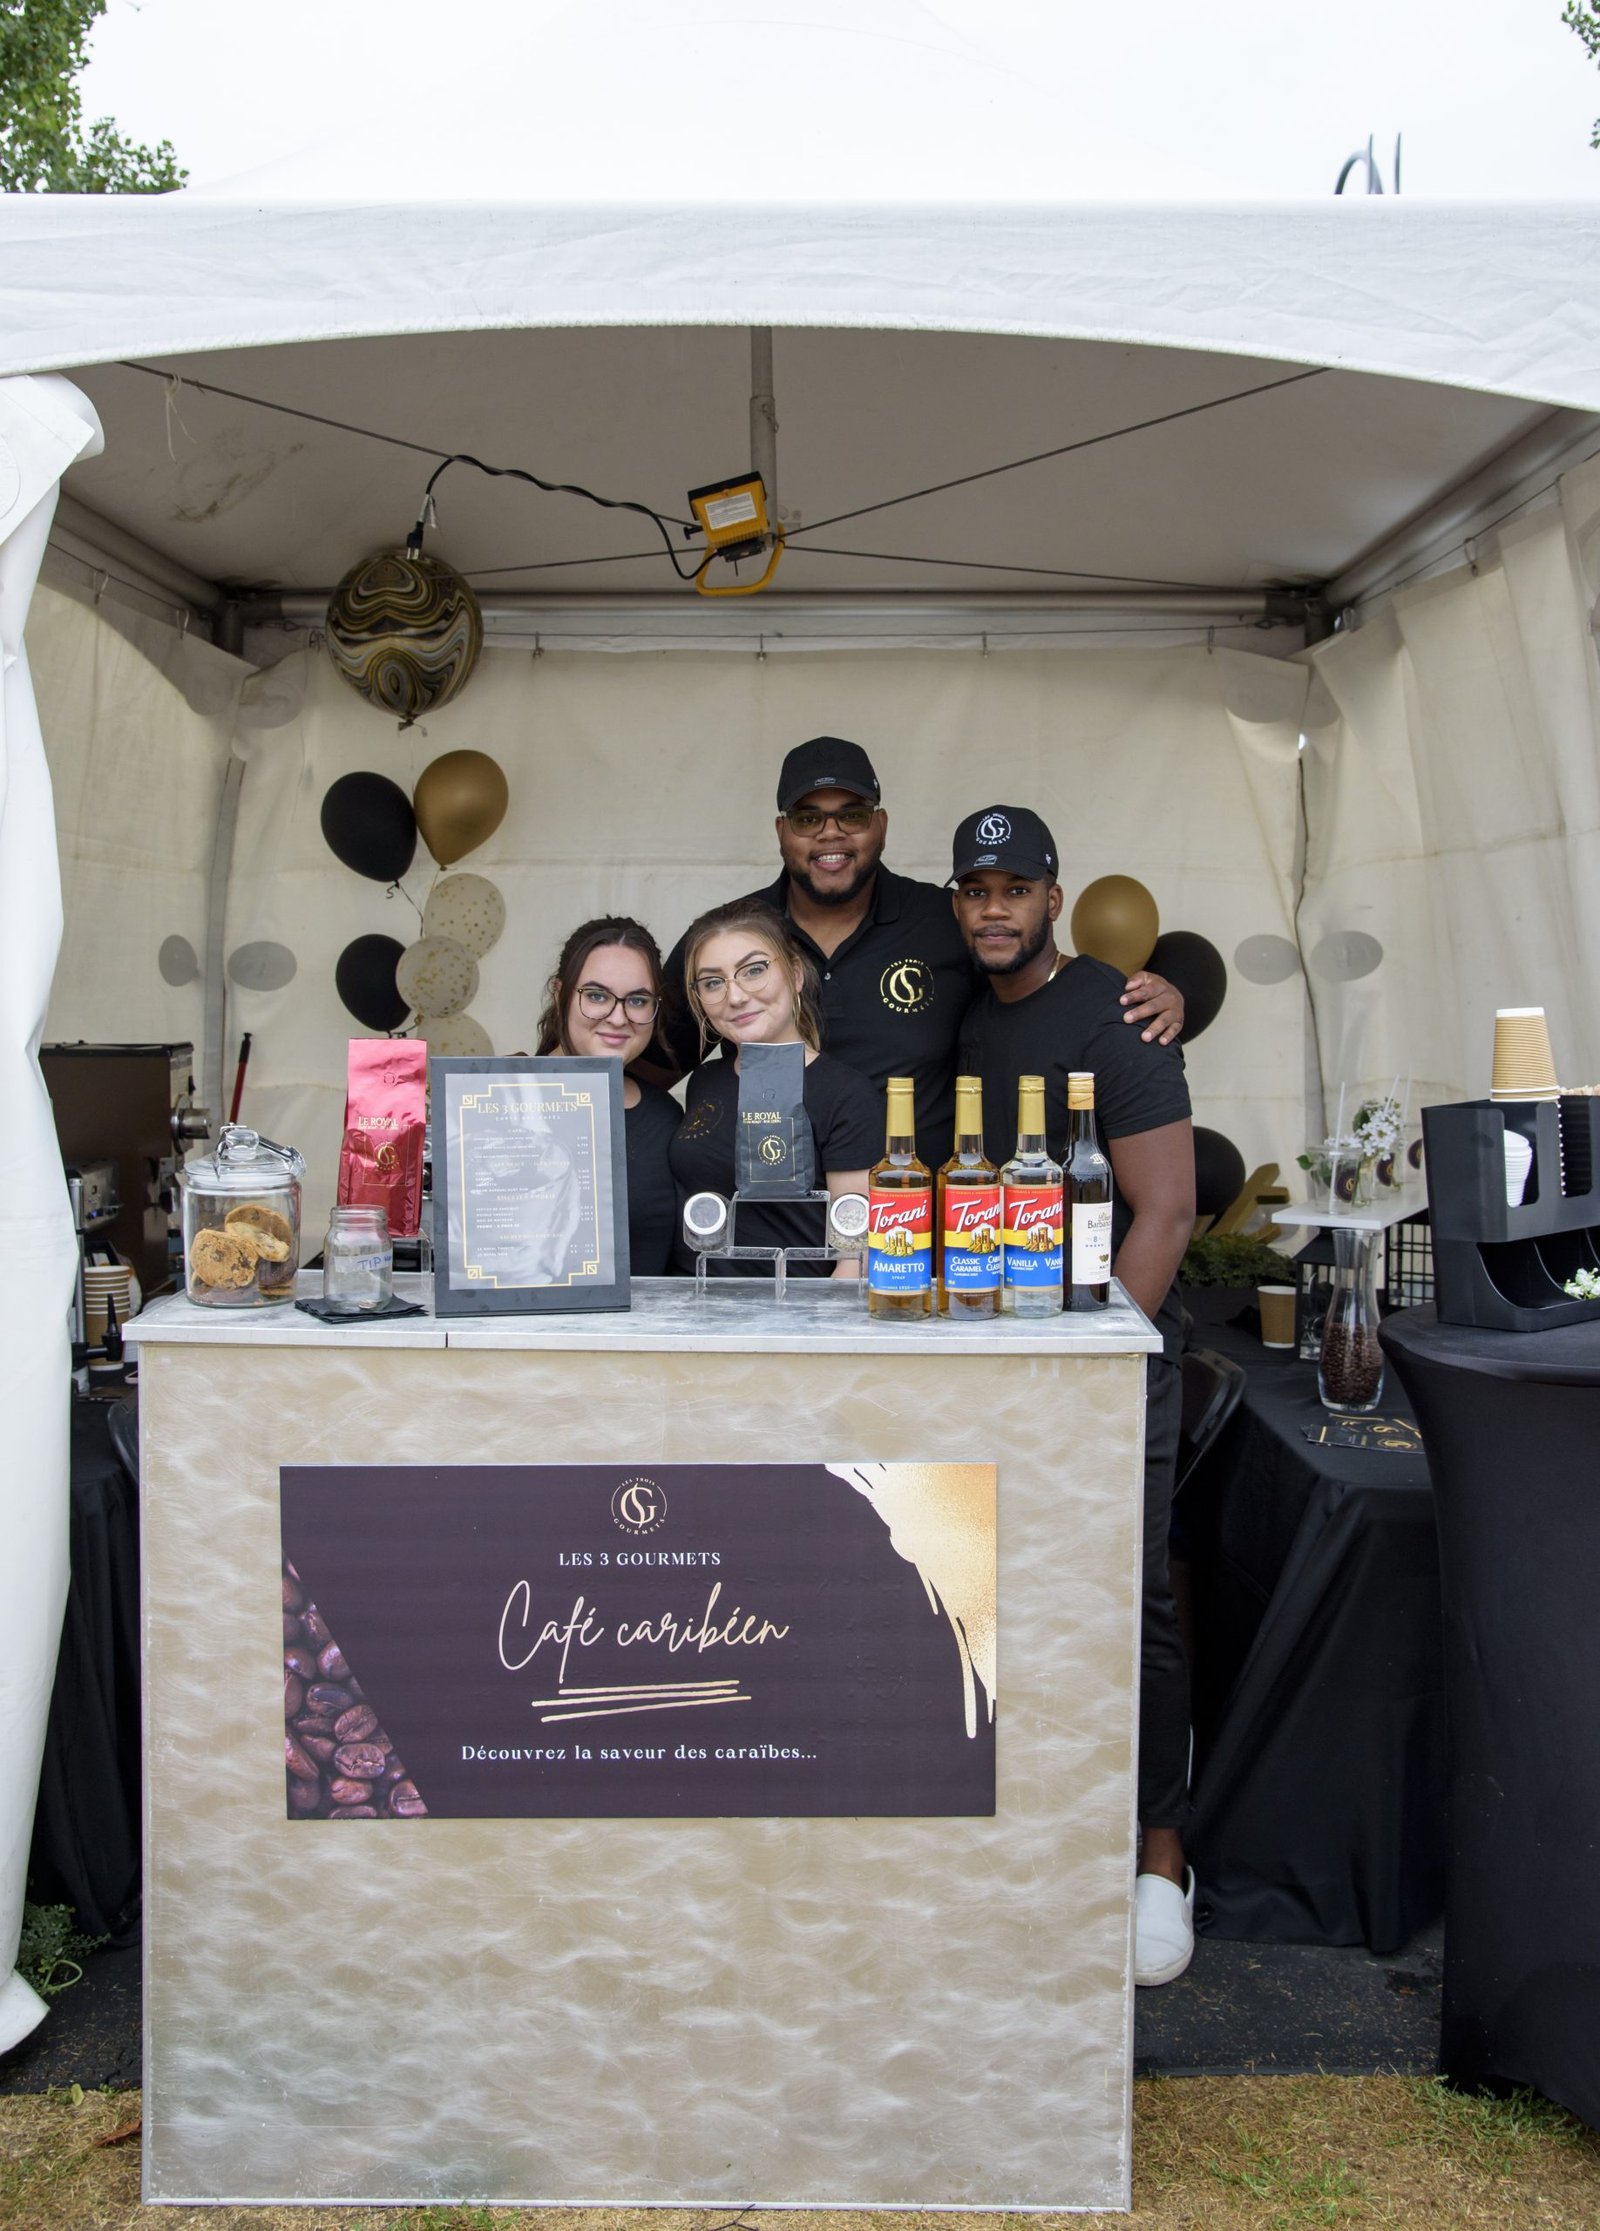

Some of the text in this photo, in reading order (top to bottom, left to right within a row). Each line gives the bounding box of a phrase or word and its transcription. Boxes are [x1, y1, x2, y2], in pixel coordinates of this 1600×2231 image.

[478, 1102, 578, 1115] LES 3 GOURMETS
[358, 1116, 399, 1127] LE ROYAL
[742, 1111, 782, 1120] LE ROYAL
[870, 1199, 927, 1235] Torani
[951, 1198, 1000, 1235] Toran
[873, 1260, 925, 1273] AMARETTO
[951, 1256, 981, 1265] CLASSIC
[1006, 1256, 1038, 1268] VANILLA
[950, 1264, 983, 1273] CARAMEL
[635, 1477, 656, 1486] TROIS
[613, 1517, 665, 1535] GOURMETS
[559, 1552, 722, 1567] LES 3 GOURMETS
[499, 1580, 790, 1684] Café caribéen
[461, 1743, 818, 1760] Découvrez la saveur des caraïbes...
